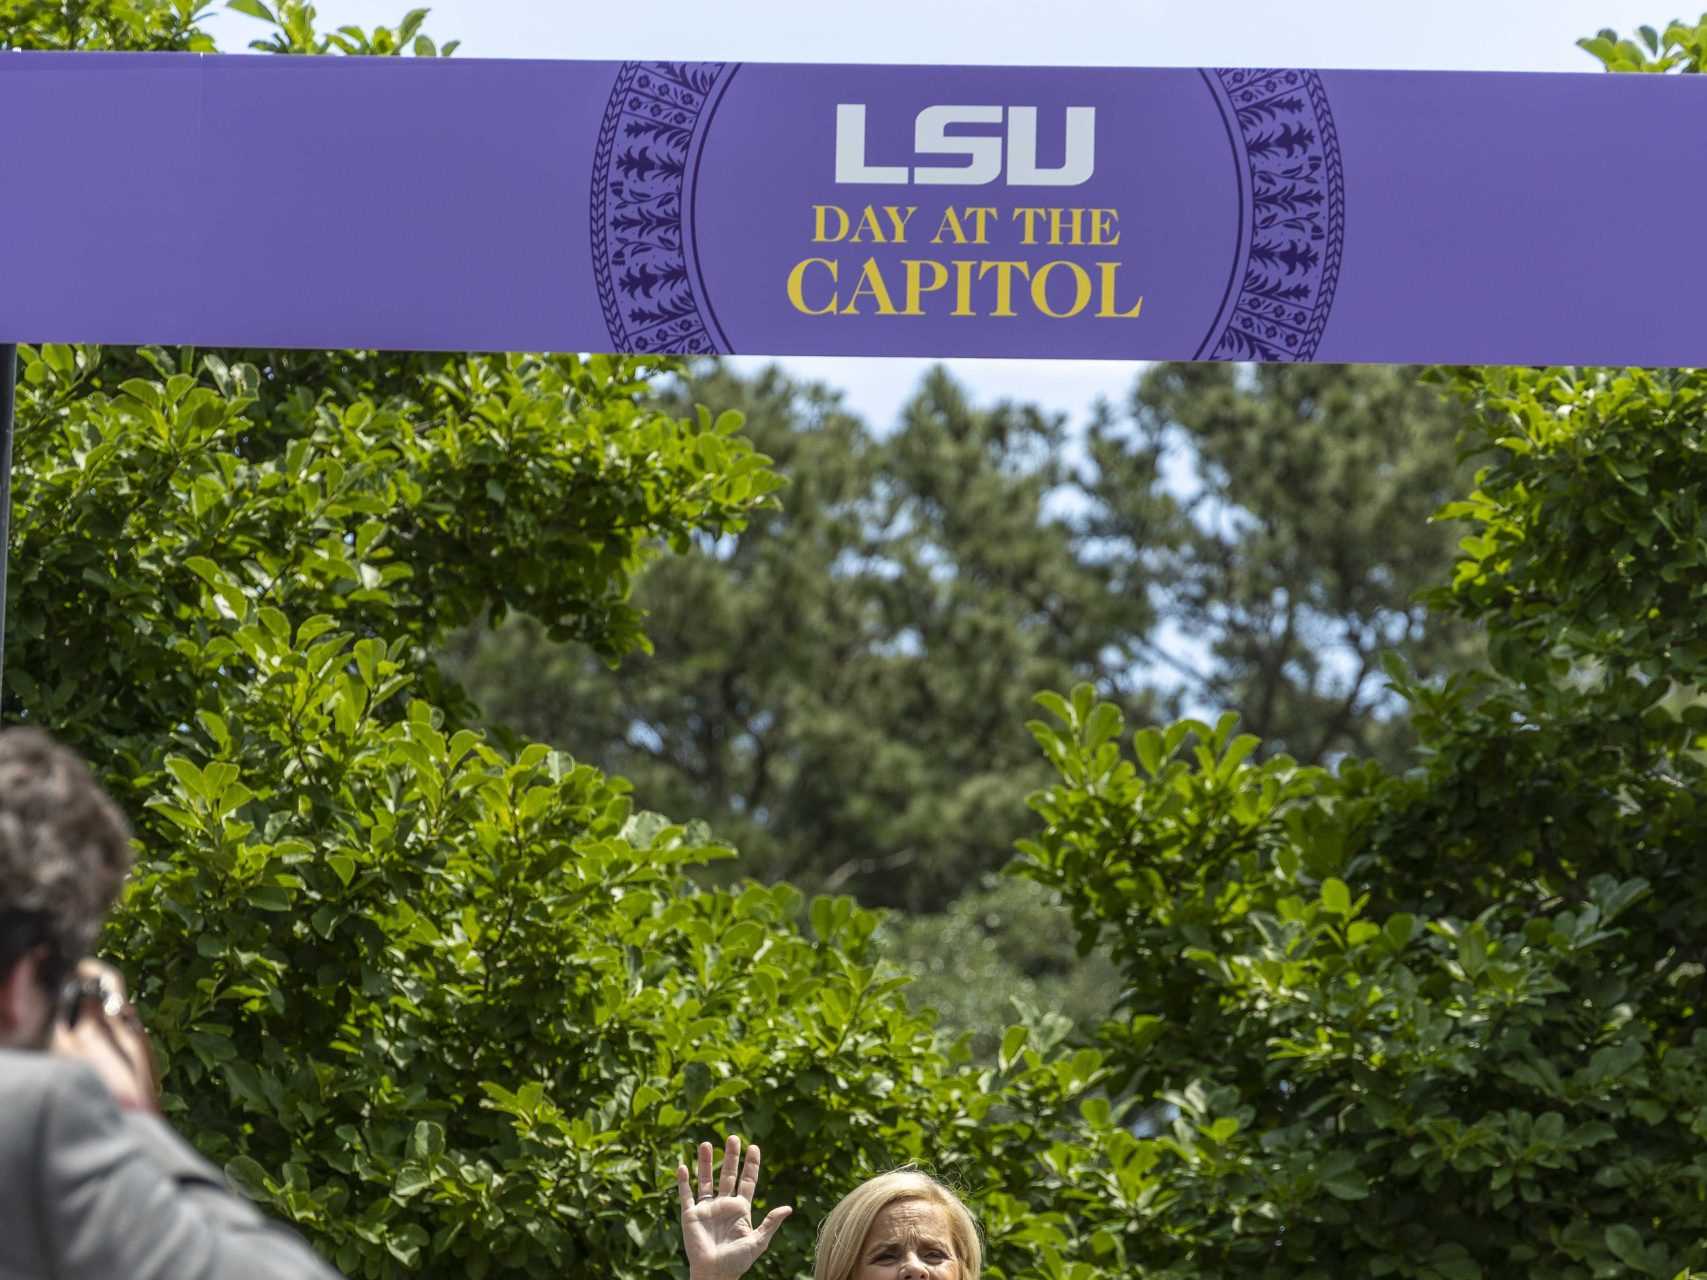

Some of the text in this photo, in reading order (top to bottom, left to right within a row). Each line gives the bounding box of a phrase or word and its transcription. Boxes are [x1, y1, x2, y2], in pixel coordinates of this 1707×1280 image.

[835, 104, 1095, 185] LSU
[812, 204, 1121, 246] DAY AT THE
[787, 257, 1143, 318] CAPITOL
